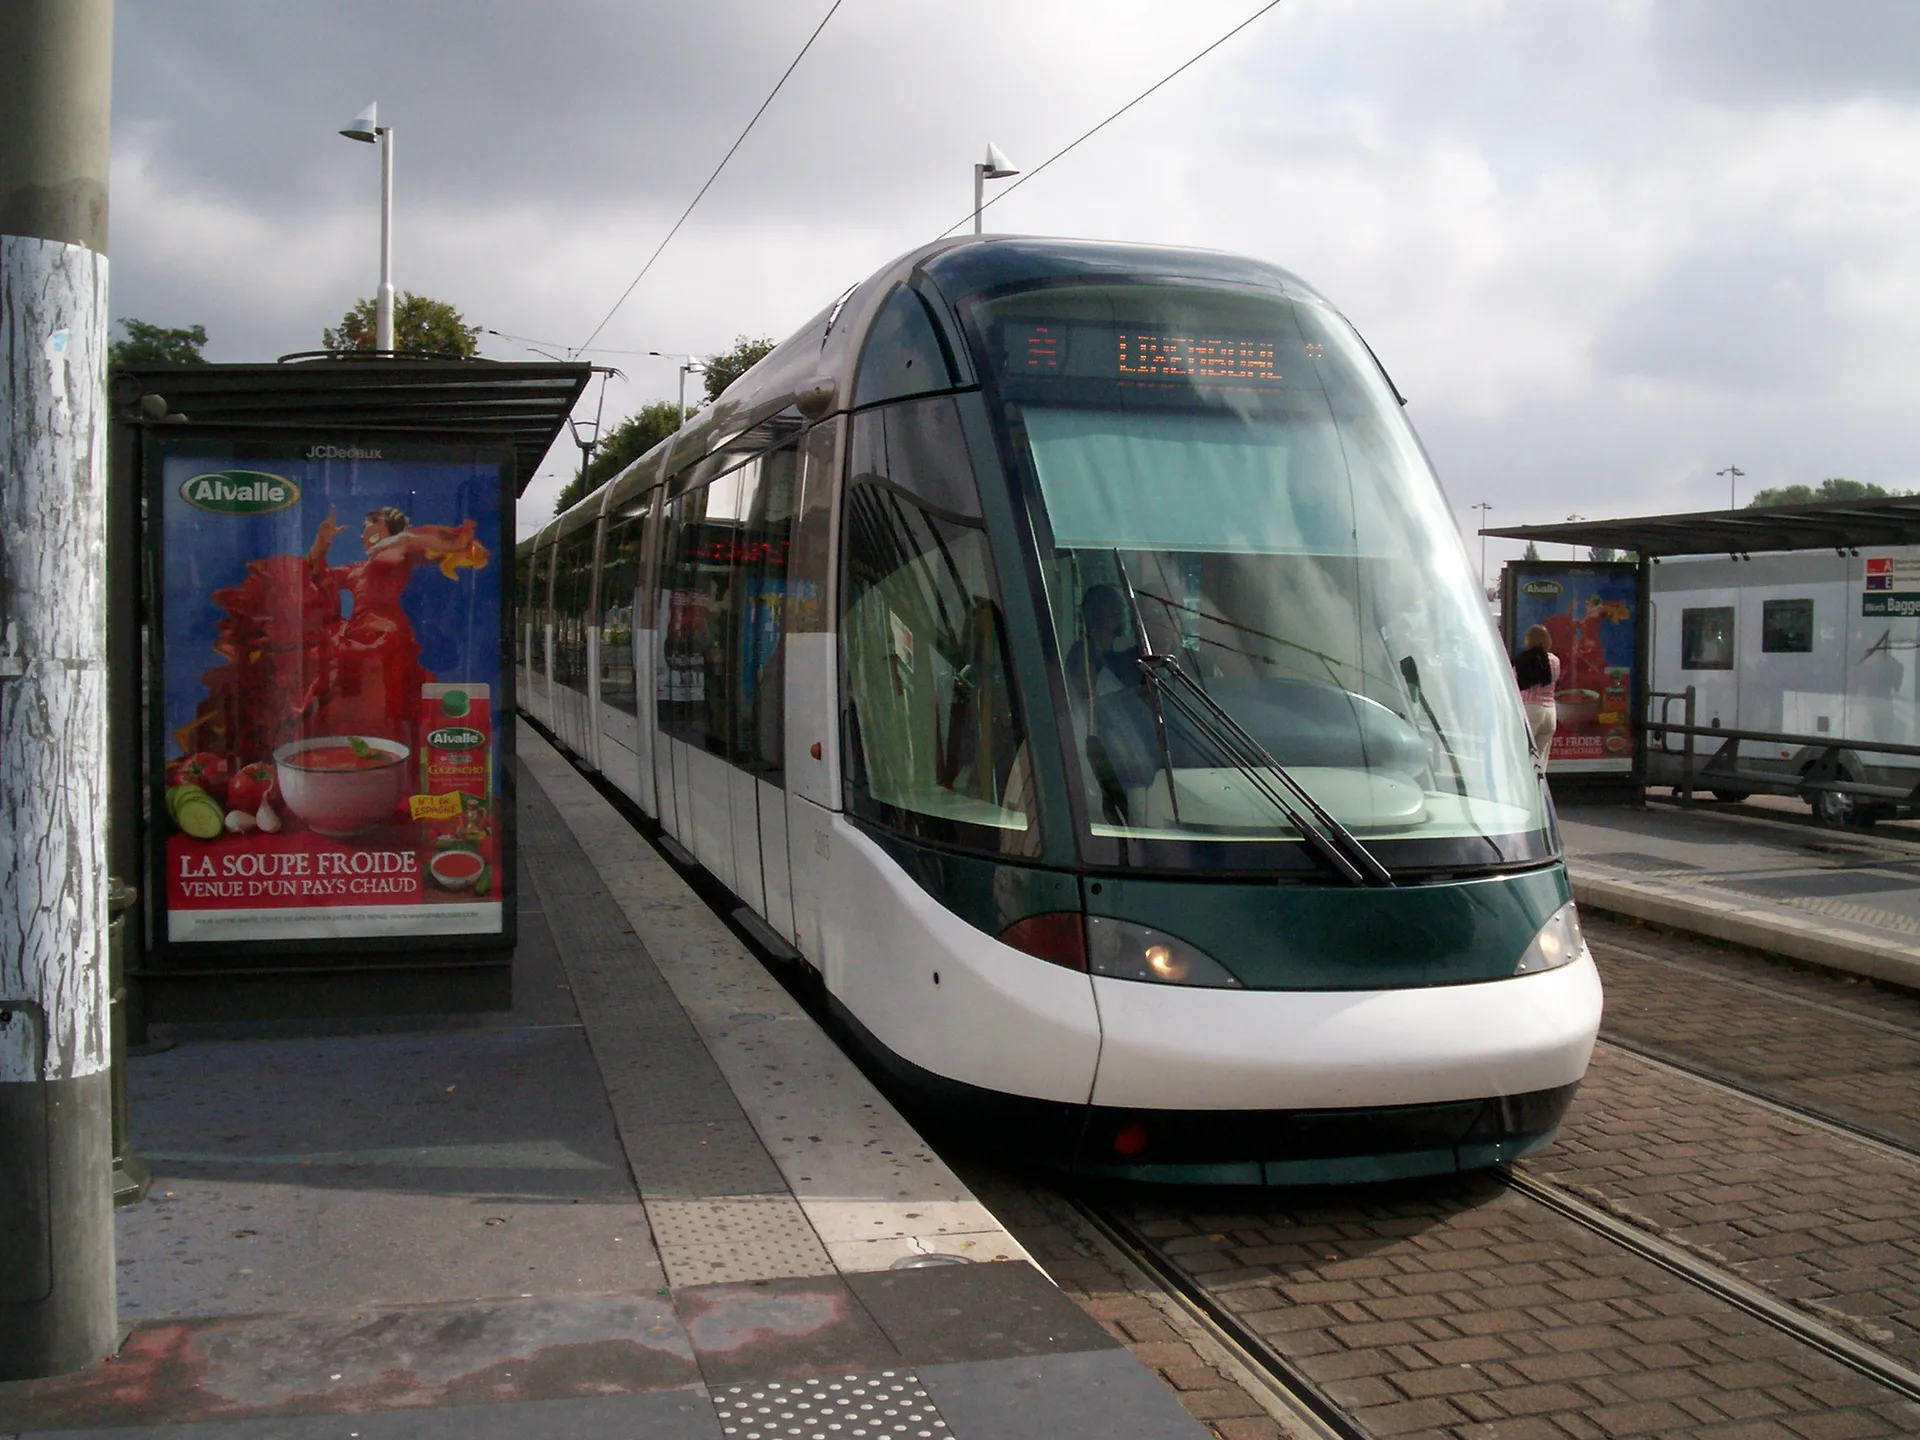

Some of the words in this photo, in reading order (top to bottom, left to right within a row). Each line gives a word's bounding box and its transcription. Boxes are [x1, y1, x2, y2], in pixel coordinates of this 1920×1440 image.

[306, 445, 382, 459] JCDecaux
[195, 481, 285, 502] Alvalle
[1883, 559, 1892, 571] A
[1885, 576, 1892, 589] E
[433, 733, 479, 744] Alvalle
[179, 855, 217, 878] LA
[222, 853, 311, 877] SOUPE
[316, 851, 417, 875] FROIDE
[180, 881, 244, 897] VENUE
[249, 879, 297, 896] D'UN
[301, 878, 347, 895] PAYS
[349, 876, 417, 894] CHAUD
